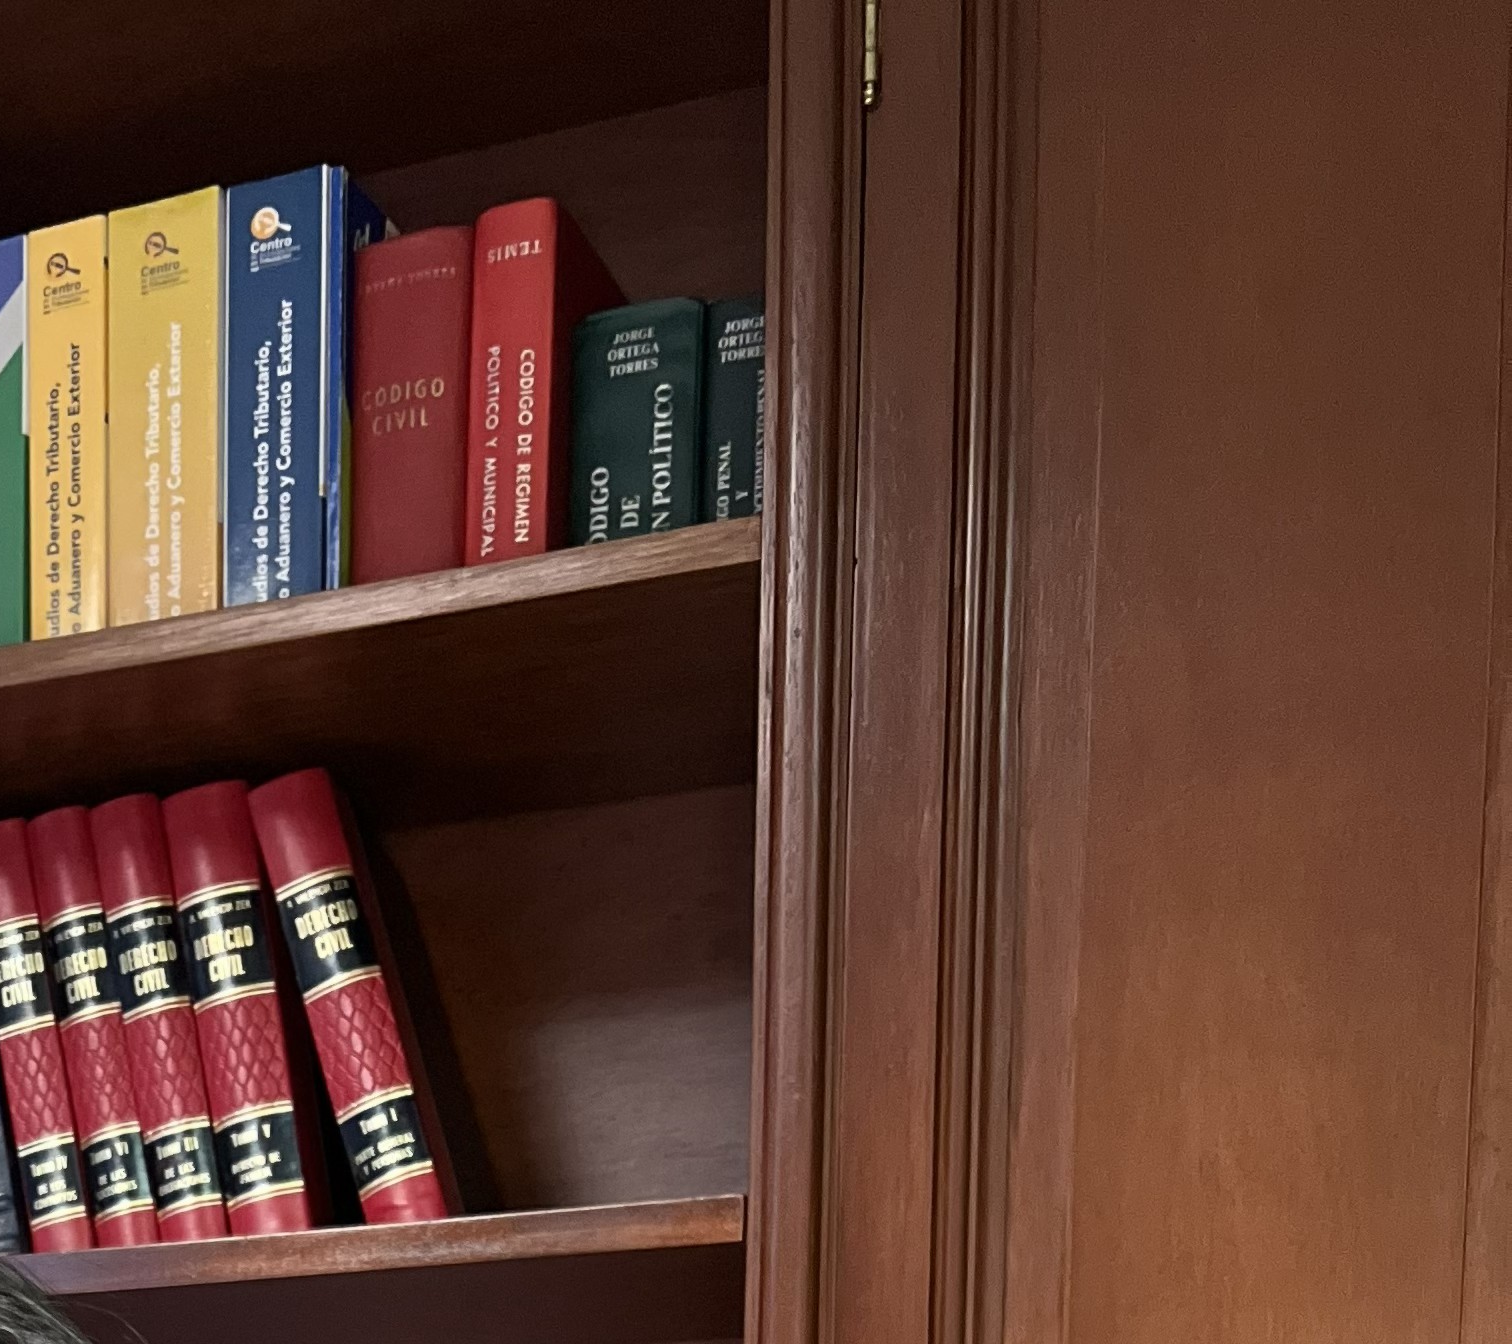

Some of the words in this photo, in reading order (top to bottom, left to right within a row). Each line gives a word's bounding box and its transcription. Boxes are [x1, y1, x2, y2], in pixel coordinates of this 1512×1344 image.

[250, 237, 292, 254] Centro
[487, 238, 542, 264] TEMIS
[141, 261, 181, 277] Centro
[43, 280, 82, 298] Centro
[277, 299, 293, 377] Exterior
[607, 341, 661, 363] ORTEGA
[613, 326, 656, 346] JORGE
[168, 322, 182, 397] Exterior
[609, 357, 659, 379] TORRES
[68, 343, 81, 417] Exterior
[253, 341, 272, 439] Tributario,
[362, 377, 445, 411] CODIGO
[485, 345, 501, 431] POLITICO
[517, 348, 535, 427] CODIGO
[145, 363, 162, 457] Tributario,
[276, 381, 292, 470] Comercio
[372, 406, 430, 437] CIVIL
[46, 382, 61, 476] Tributario,
[167, 402, 181, 490] Comercio
[485, 437, 497, 448] Y
[516, 433, 533, 456] DE
[648, 383, 674, 507] POLÍTICO
[68, 424, 81, 508] Comercio
[253, 441, 270, 520] Derecho
[280, 475, 295, 487] y
[717, 440, 732, 491] PENAL
[145, 463, 160, 539] Derecho
[171, 495, 185, 506] y
[481, 457, 497, 557] MUNICIPAL
[514, 462, 532, 544] REGIMEN
[620, 495, 641, 530] DE
[735, 490, 749, 501] Y
[46, 481, 60, 556] Derecho
[72, 513, 85, 524] y
[146, 544, 159, 567] de
[166, 512, 182, 599] Aduanero
[252, 526, 269, 549] de
[275, 492, 291, 583] Aduanero
[46, 562, 60, 584] de
[68, 529, 82, 616] Aduanero
[294, 898, 358, 940] DERECHO
[118, 939, 178, 975] DERECHO
[193, 924, 255, 961] DERECHO
[314, 927, 355, 960] CIVIL
[53, 946, 107, 983] DERECHO
[133, 967, 170, 997] CIVIL
[208, 953, 246, 983] CIVIL
[1, 979, 37, 1008] CIVIL
[65, 975, 100, 1005] CIVIL
